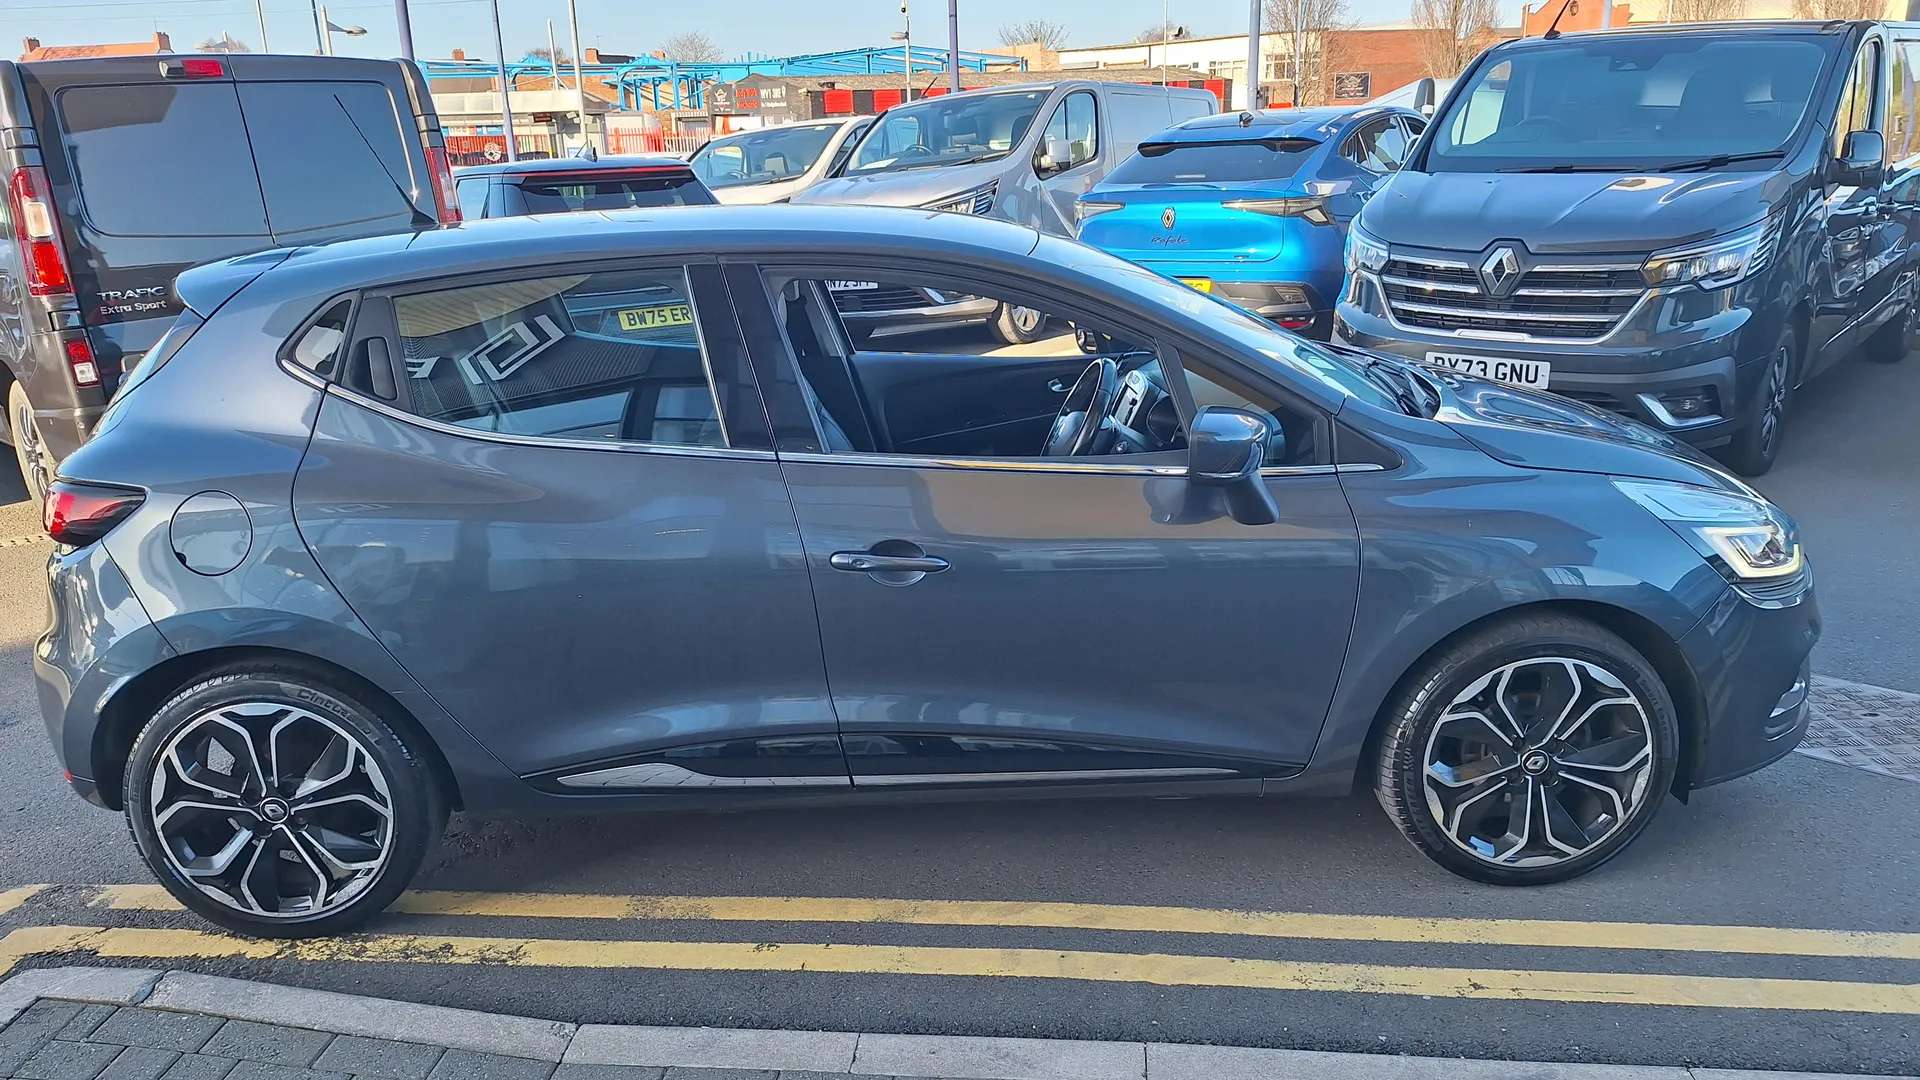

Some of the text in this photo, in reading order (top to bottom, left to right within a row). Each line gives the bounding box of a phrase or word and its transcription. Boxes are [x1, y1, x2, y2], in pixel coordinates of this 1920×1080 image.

[100, 300, 167, 315] Extra Sport
[625, 309, 668, 327] BW75
[1494, 362, 1539, 384] GNU
